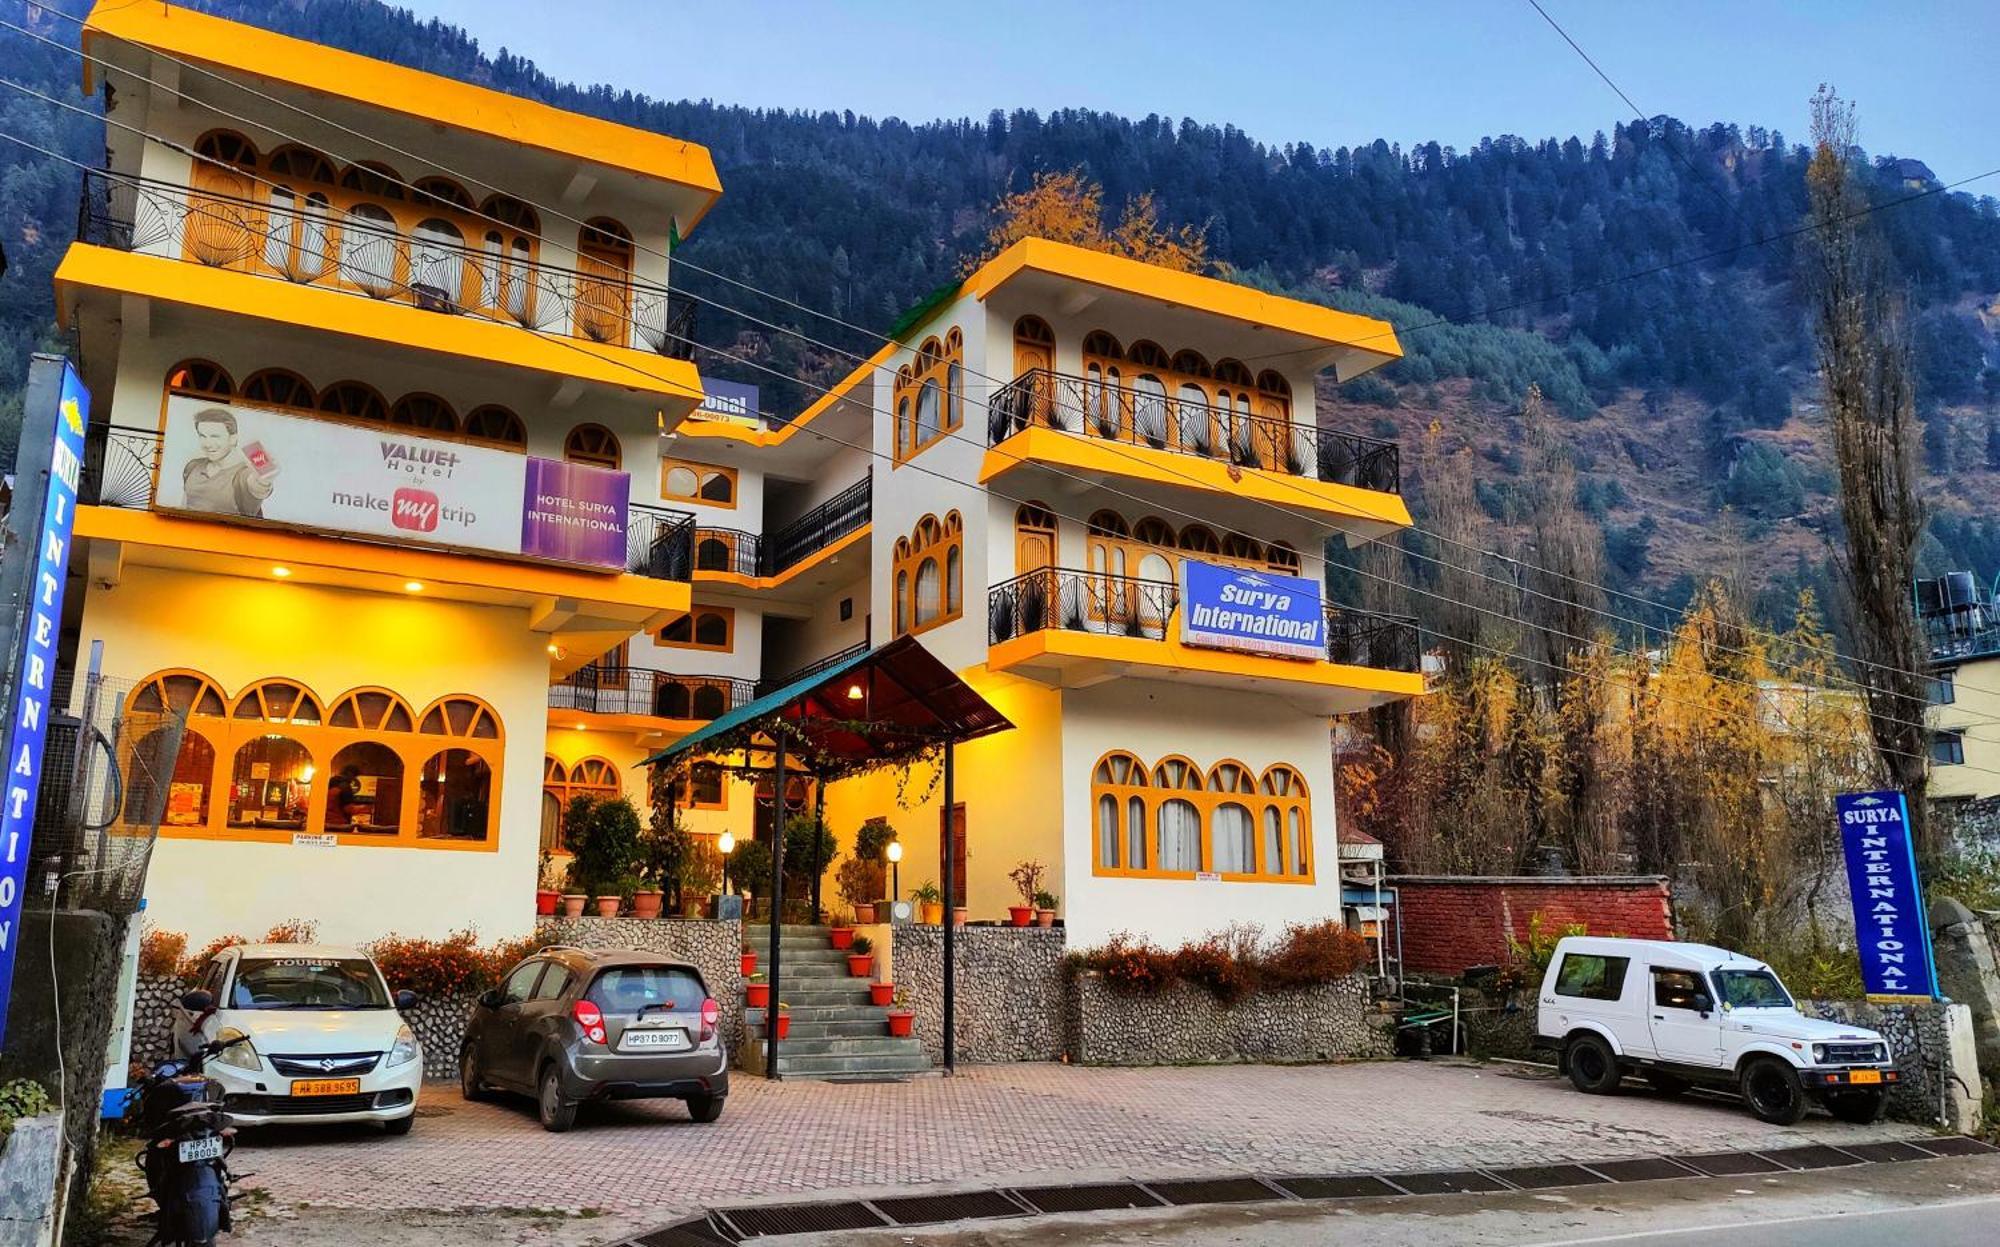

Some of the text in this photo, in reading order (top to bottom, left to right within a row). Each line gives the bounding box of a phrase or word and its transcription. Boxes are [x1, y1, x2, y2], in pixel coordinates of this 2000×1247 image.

[387, 459, 453, 479] Hotel
[413, 476, 425, 485] by
[332, 491, 476, 529] make my trip
[536, 494, 617, 515] HOTEL SURYA
[527, 510, 624, 533] INTERNATIONAL
[1220, 584, 1291, 611] Surya
[1192, 603, 1318, 641] International
[1844, 807, 1902, 824] SURYA
[1861, 825, 1908, 990] INTERNATIONAL
[272, 958, 342, 968] TOURIST
[190, 1139, 213, 1150] HP31
